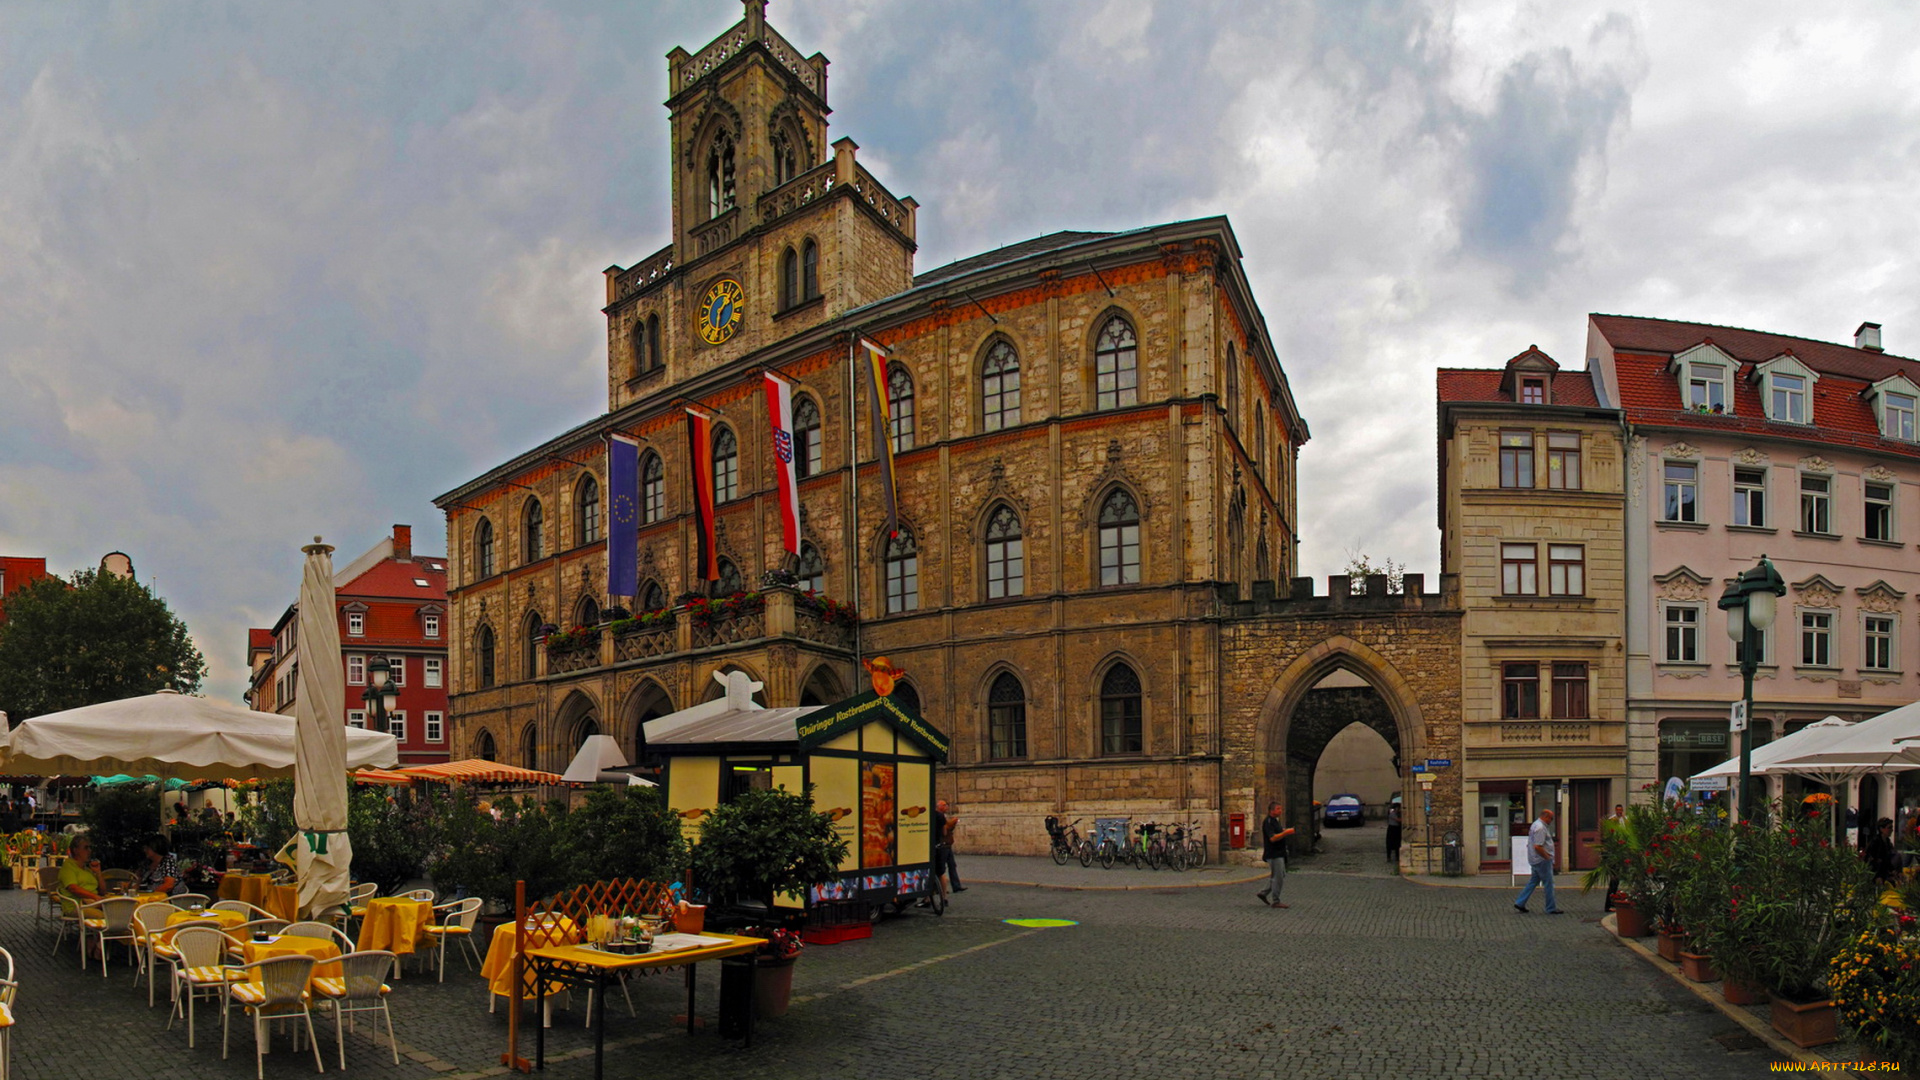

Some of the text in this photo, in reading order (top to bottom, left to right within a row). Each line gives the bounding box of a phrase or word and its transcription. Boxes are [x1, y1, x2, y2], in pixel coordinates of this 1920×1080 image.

[798, 696, 884, 738] Thüringer Rostbratwurst
[882, 697, 948, 754] Thüringer Rostbratwurst
